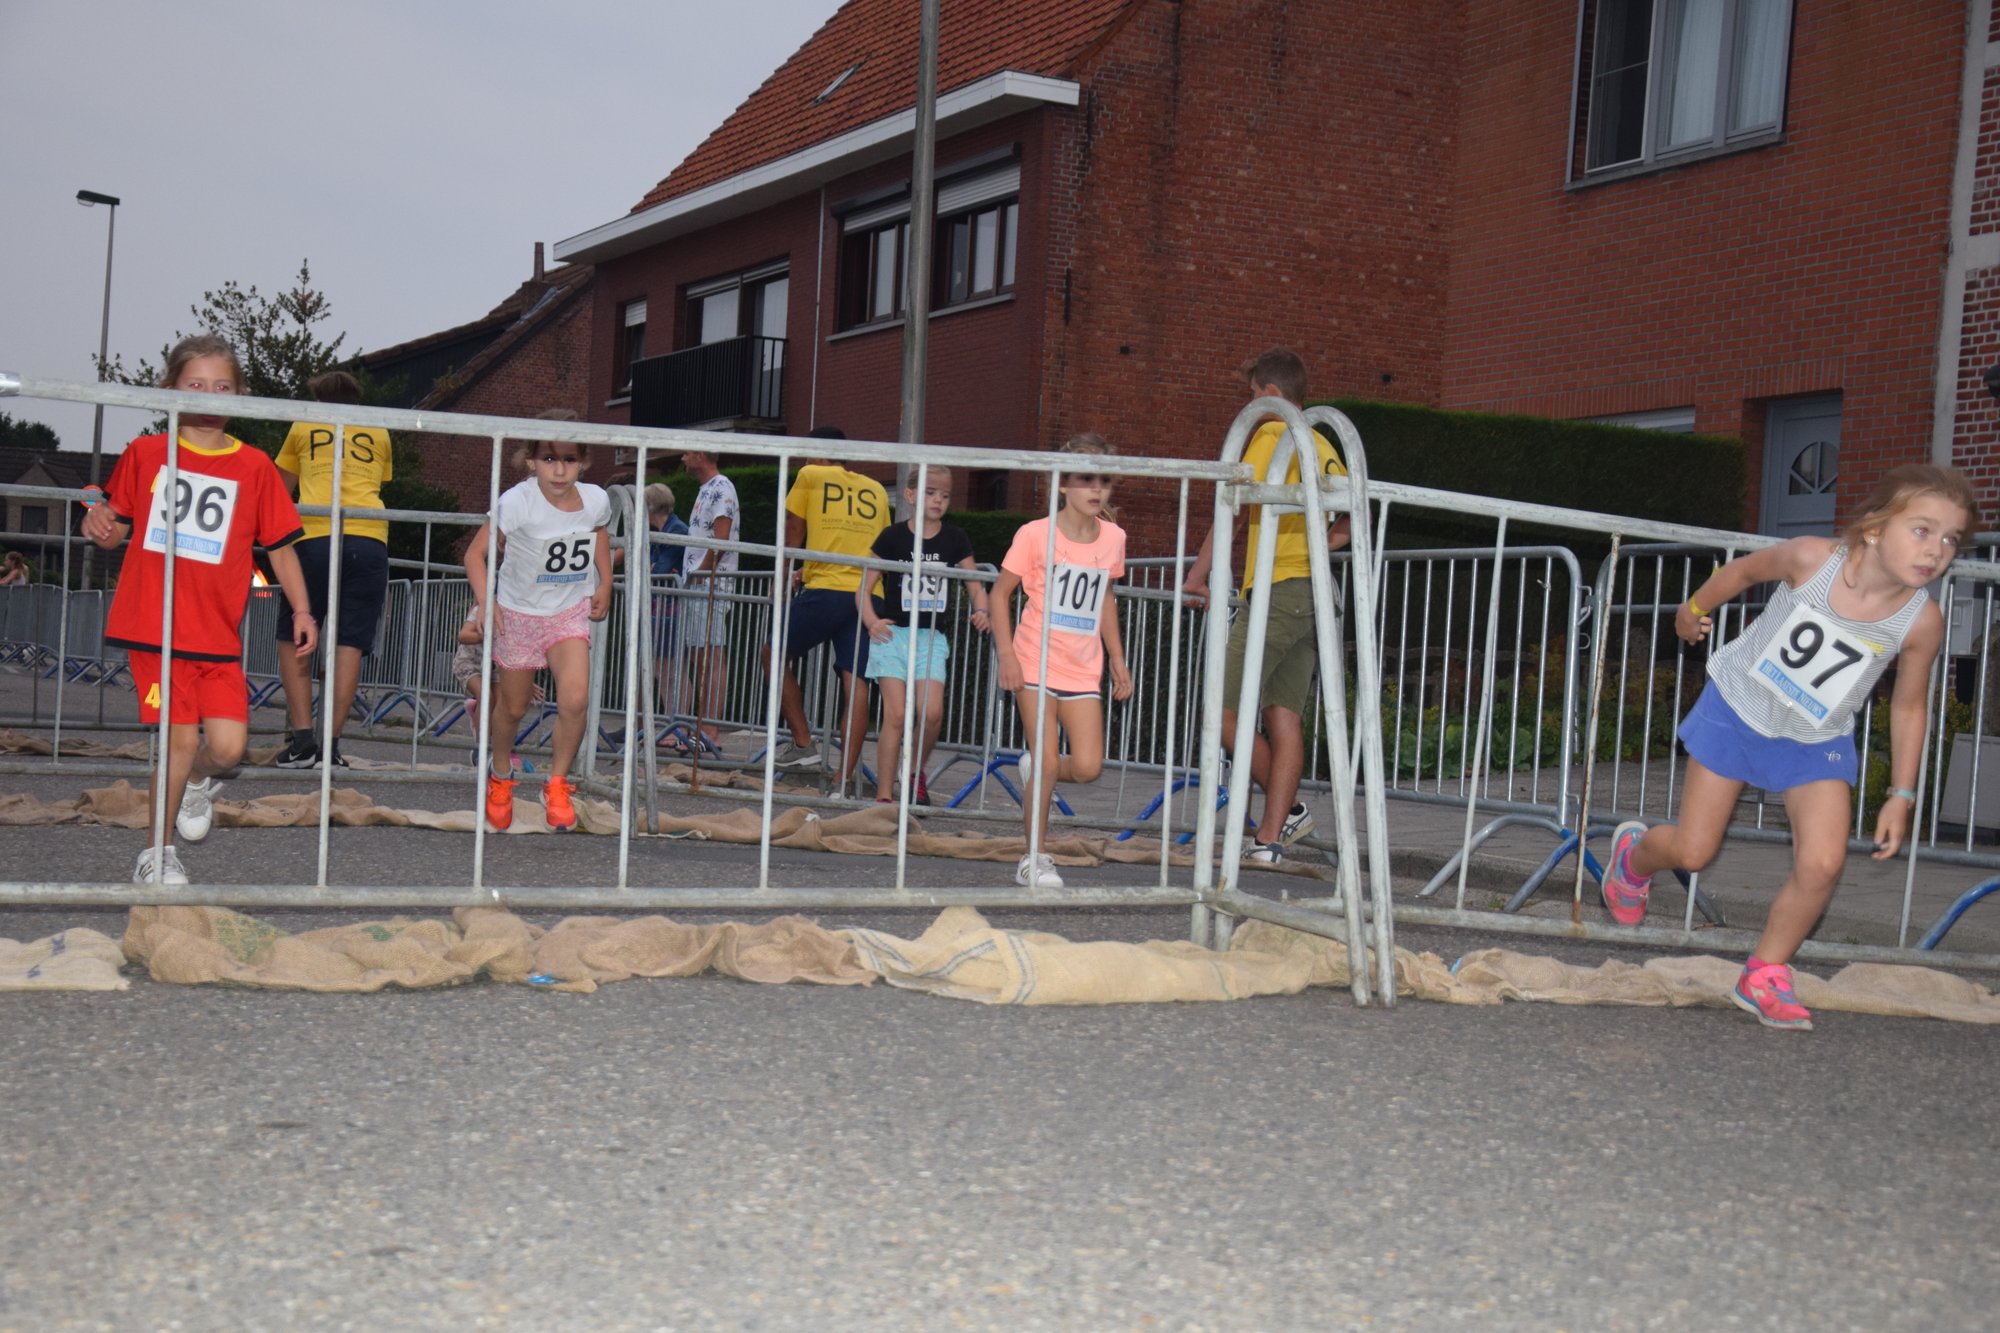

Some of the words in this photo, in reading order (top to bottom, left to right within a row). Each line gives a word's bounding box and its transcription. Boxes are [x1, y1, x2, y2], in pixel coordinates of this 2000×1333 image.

[310, 429, 375, 464] PiS
[160, 477, 227, 532] 96
[822, 482, 878, 520] PiS
[545, 538, 591, 573] 85
[1058, 568, 1102, 612] 101
[1780, 620, 1864, 690] 97
[144, 682, 161, 709] 4
